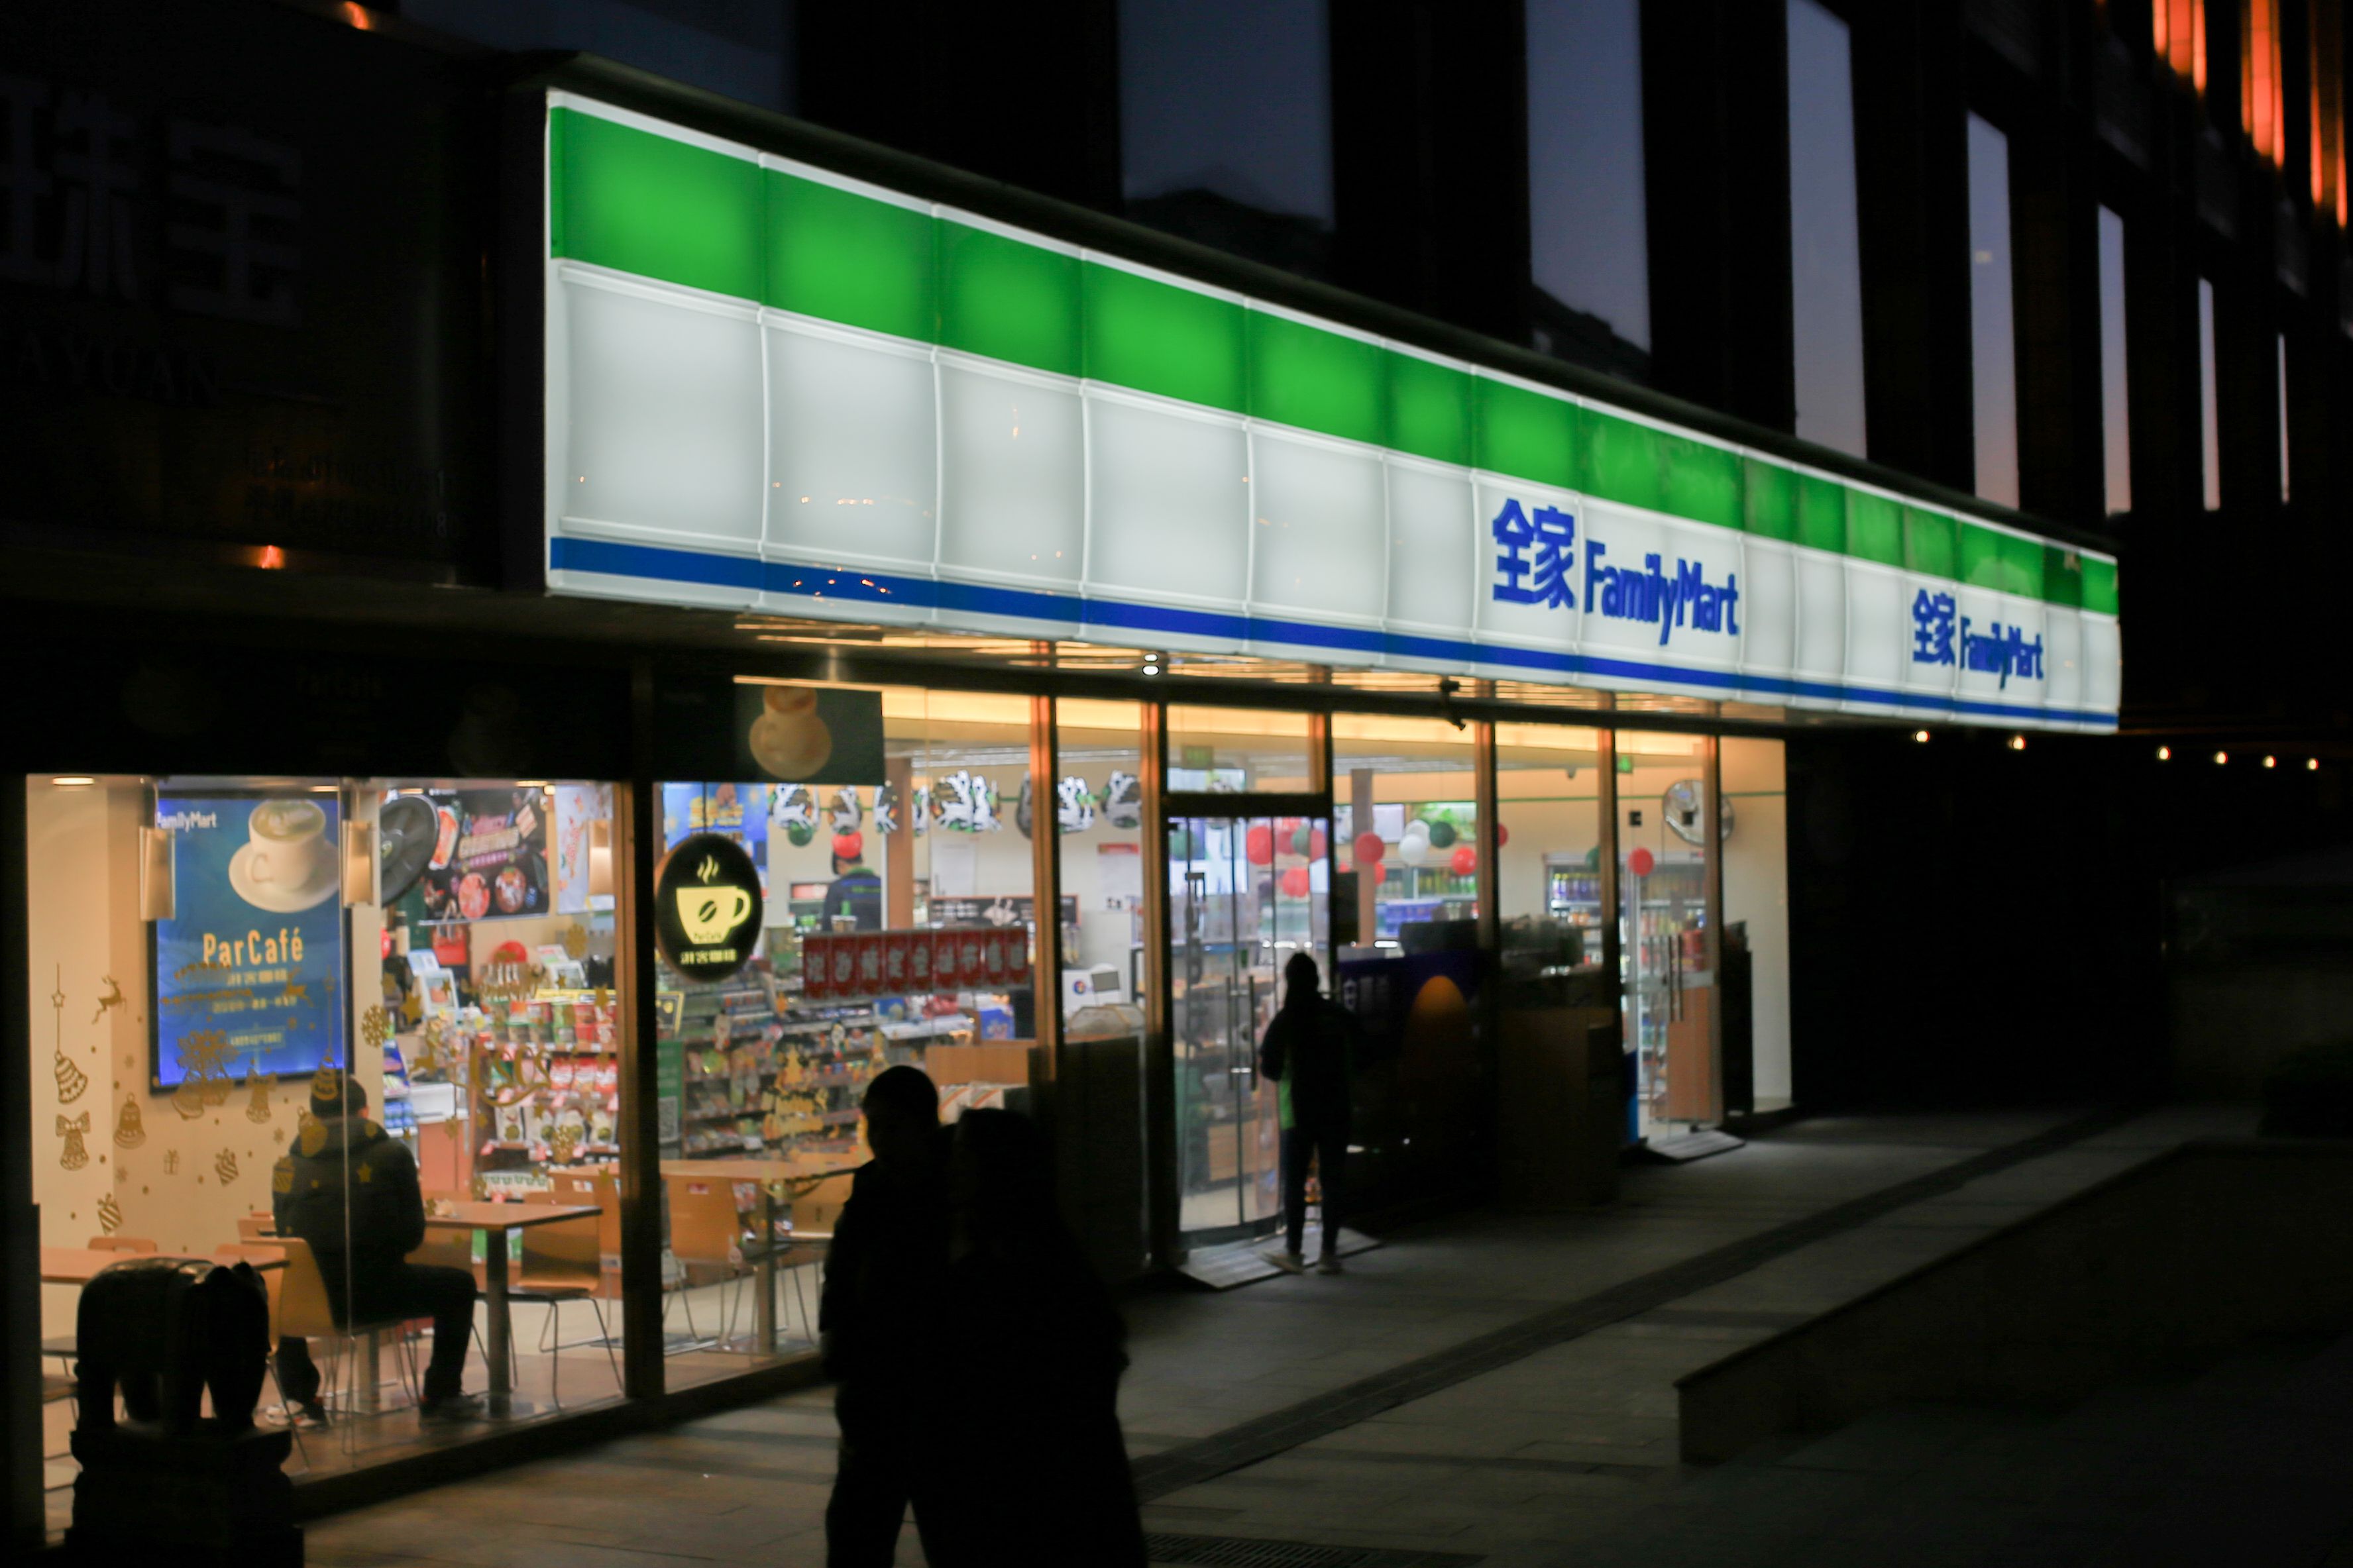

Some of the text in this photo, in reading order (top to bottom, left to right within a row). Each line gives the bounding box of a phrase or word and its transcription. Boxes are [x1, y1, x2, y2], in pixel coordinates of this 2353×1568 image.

[1491, 498, 1739, 647] 全家 FamilyMart
[1911, 588, 2044, 690] 全家 FamilyMart
[202, 927, 305, 969] ParCafé
